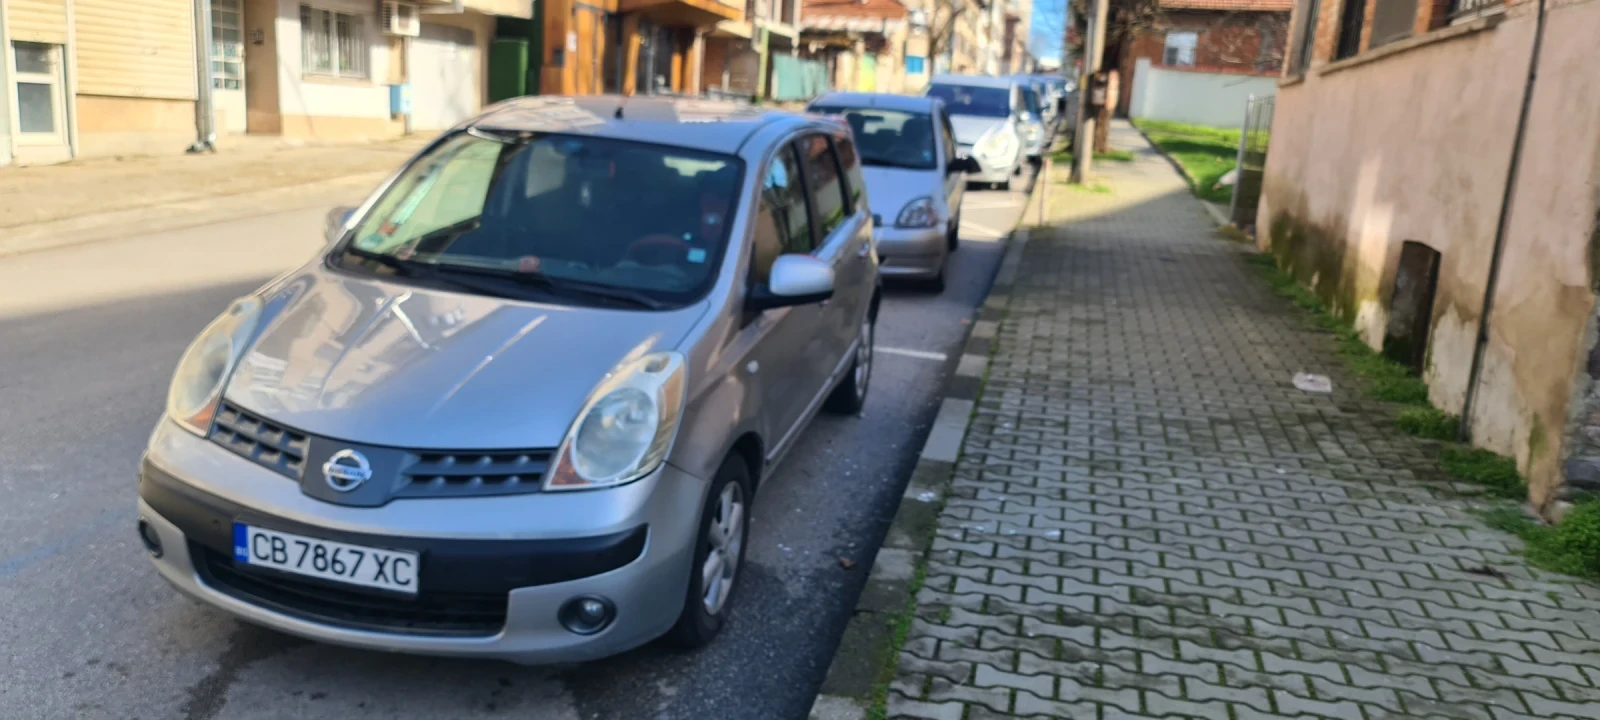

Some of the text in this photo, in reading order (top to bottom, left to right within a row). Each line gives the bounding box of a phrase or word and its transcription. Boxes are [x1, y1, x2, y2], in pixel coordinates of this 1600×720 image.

[253, 533, 411, 585] CB 7867 XC
